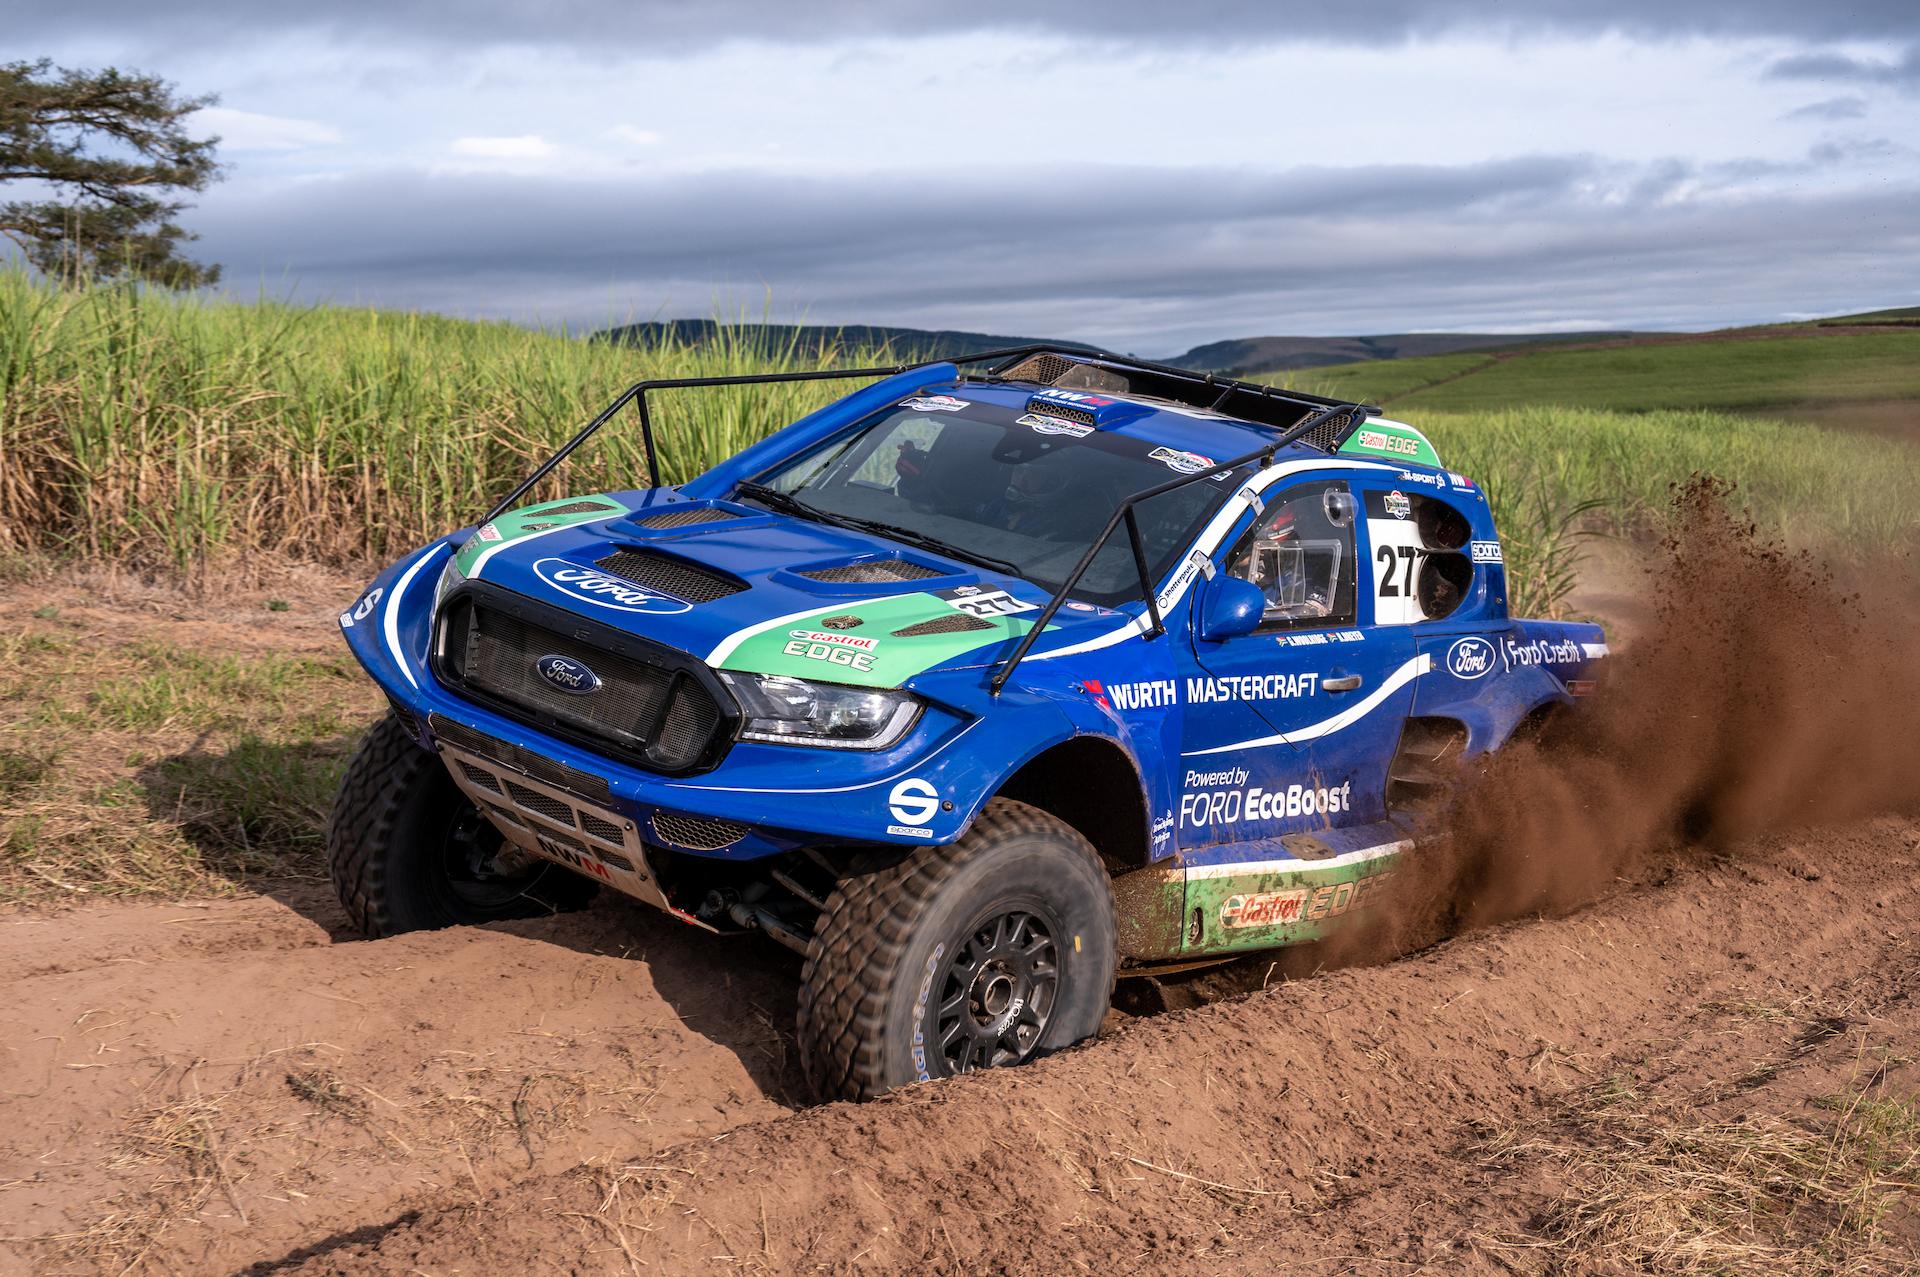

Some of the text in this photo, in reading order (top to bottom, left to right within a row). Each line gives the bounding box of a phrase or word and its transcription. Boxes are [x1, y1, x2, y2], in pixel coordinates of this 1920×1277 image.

[1364, 432, 1420, 455] Castrol EDGE
[1377, 544, 1427, 598] 27
[553, 569, 667, 605] Ford
[958, 595, 1025, 617] 277
[810, 632, 873, 649] Castrol
[1455, 639, 1582, 673] Ford Ford Credit
[782, 640, 879, 673] EDGE
[546, 659, 583, 688] Ford
[1107, 673, 1319, 710] WÜRTH MASTERCRAFT
[1184, 767, 1250, 788] Powered by
[1179, 780, 1350, 829] FORD EcoBoost
[890, 827, 930, 837] sparco
[536, 837, 612, 880] NWM
[1240, 896, 1302, 924] Castrol
